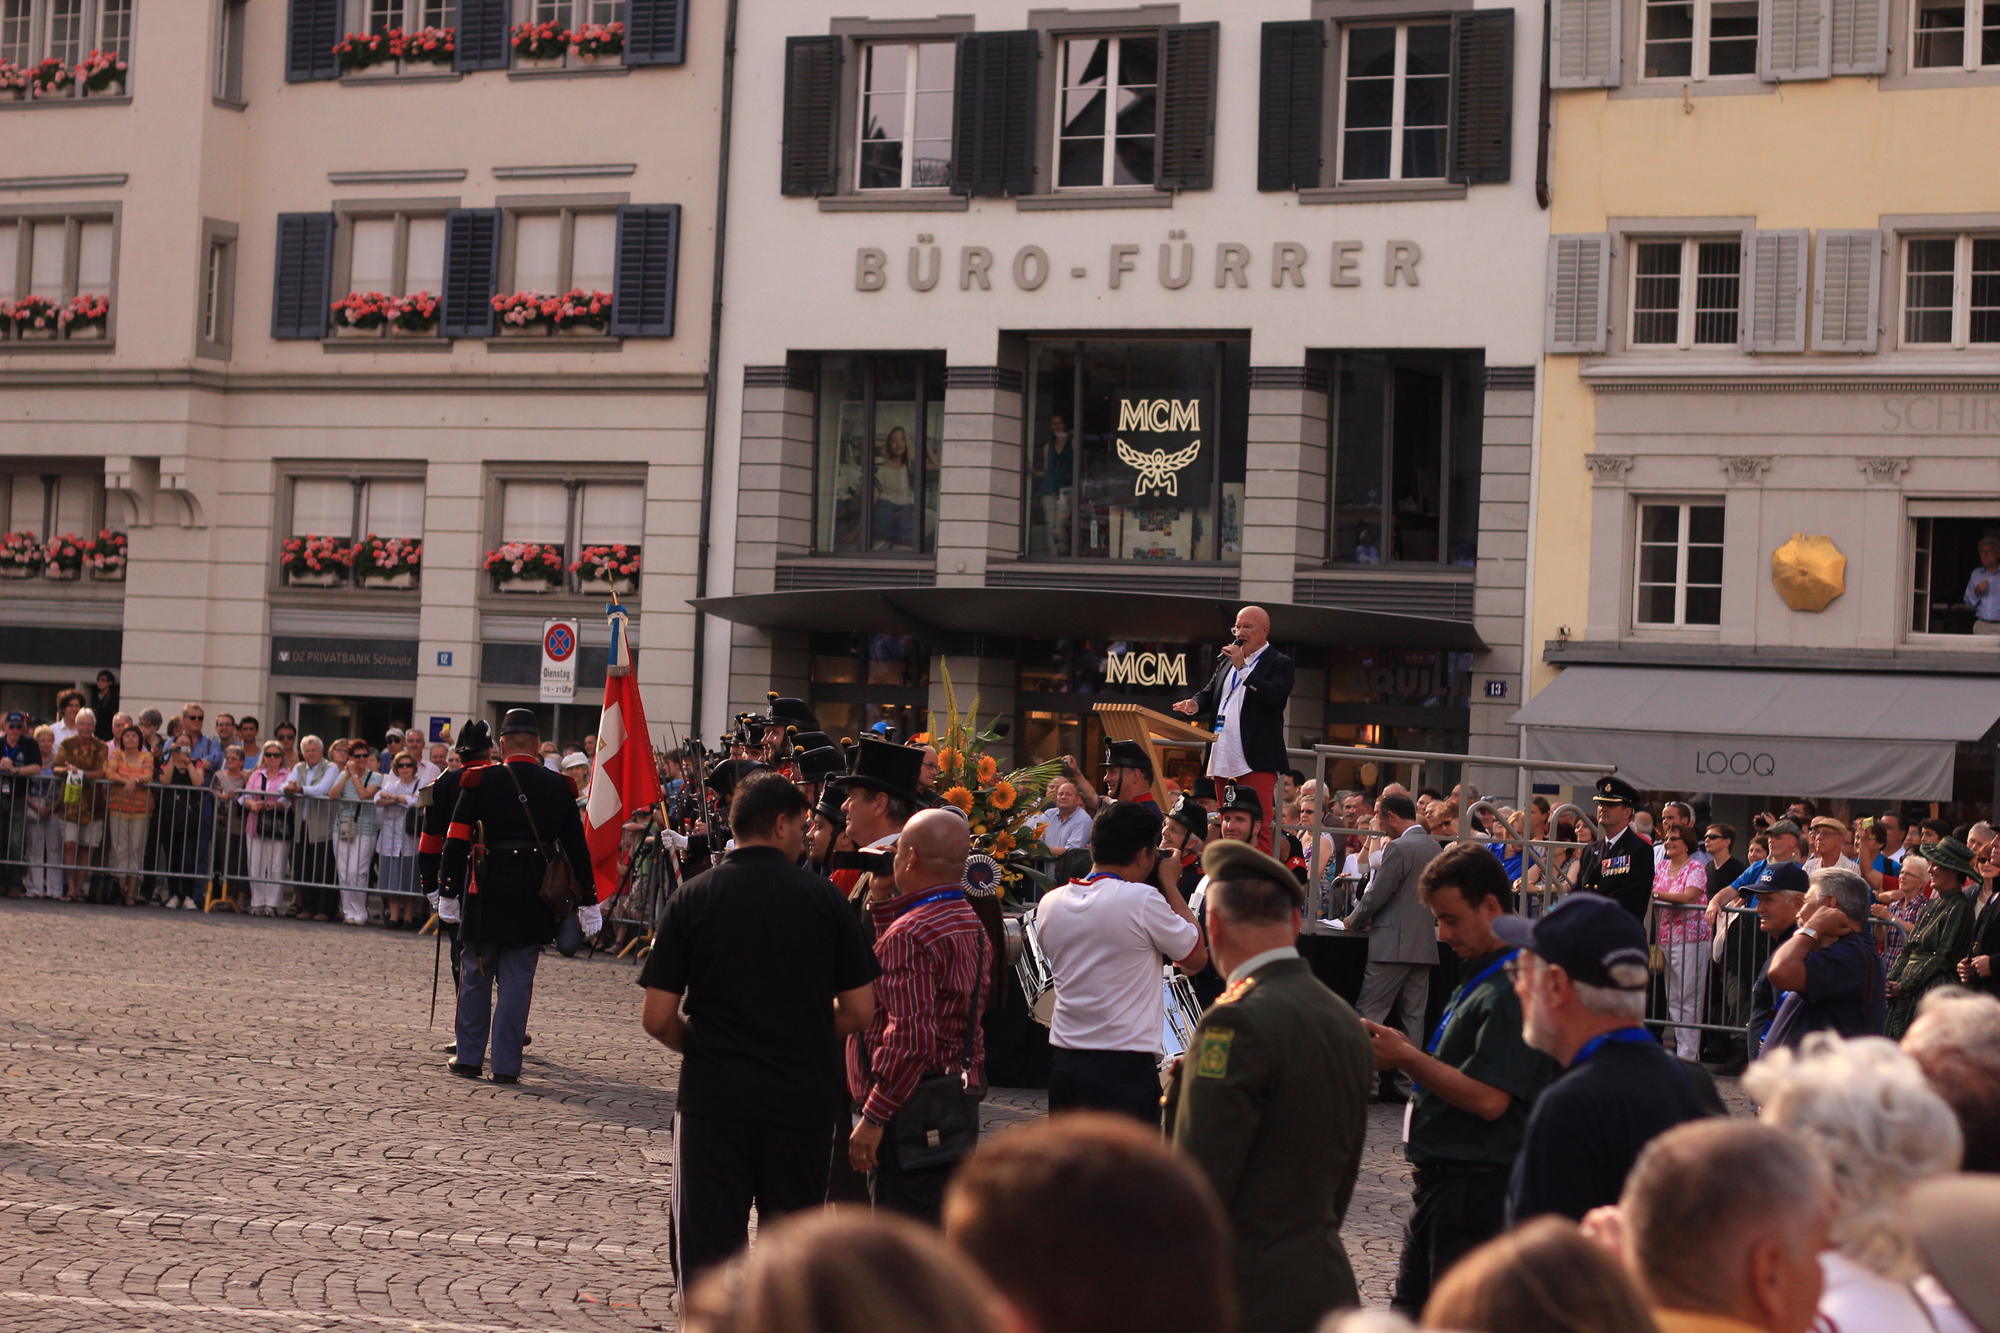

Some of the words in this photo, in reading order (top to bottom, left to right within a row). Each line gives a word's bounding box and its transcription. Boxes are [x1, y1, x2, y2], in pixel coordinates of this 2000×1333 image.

[1117, 398, 1201, 433] MCM
[292, 651, 306, 662] DZ
[307, 651, 371, 665] PRIVATBANK
[372, 653, 412, 666] Schweiz
[440, 653, 449, 665] 12
[543, 667, 570, 680] Dienstag
[1104, 651, 1189, 687] MCM
[1490, 683, 1502, 695] 13
[1696, 751, 1775, 777] LOOQ
